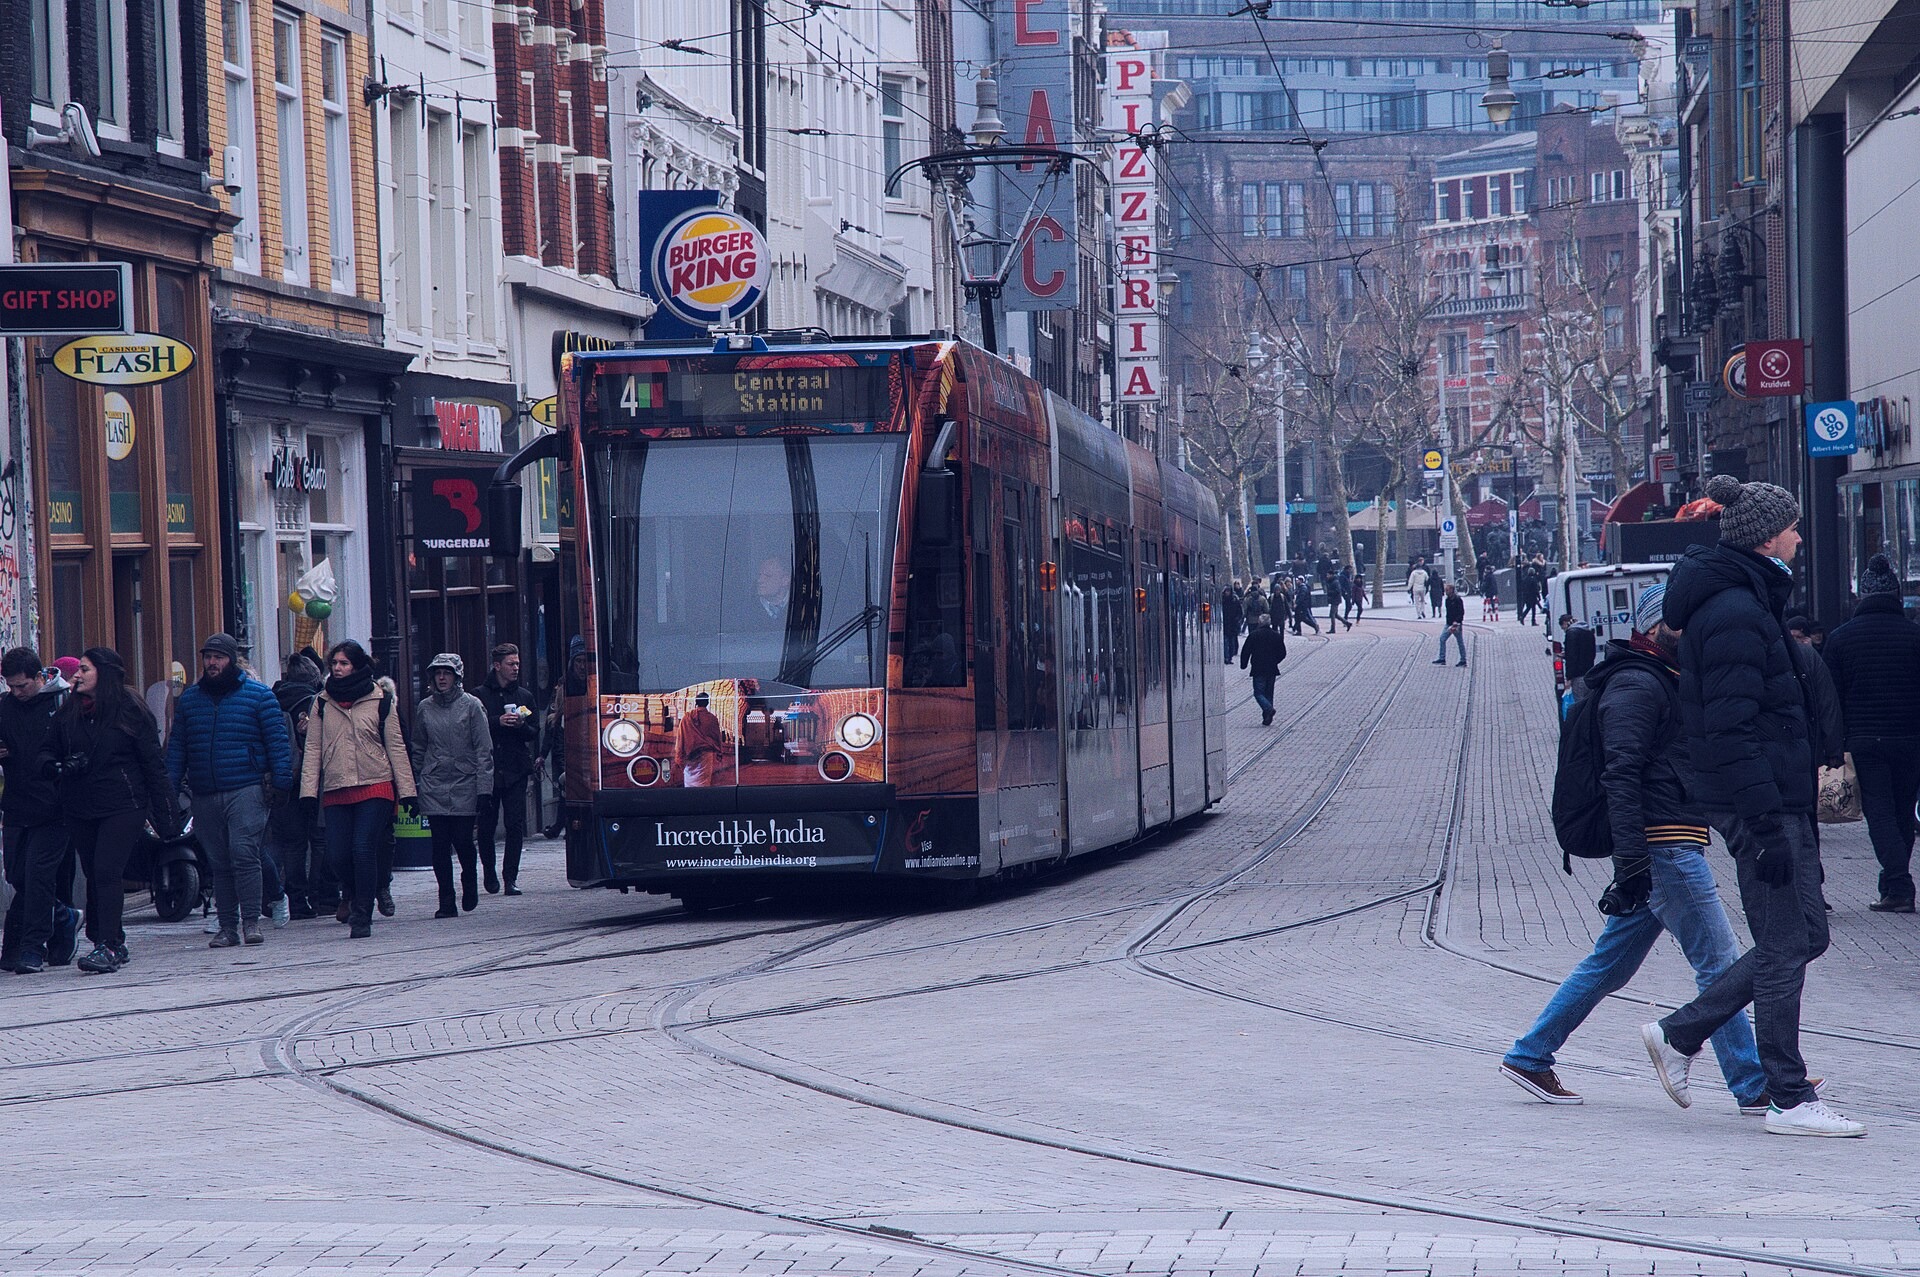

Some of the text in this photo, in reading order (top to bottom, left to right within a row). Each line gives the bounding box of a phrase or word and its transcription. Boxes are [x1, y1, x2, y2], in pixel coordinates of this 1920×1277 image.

[1116, 61, 1155, 396] PIZZERIA
[669, 232, 754, 268] BURGER
[671, 252, 757, 297] KING
[2, 290, 117, 309] GIFT SHOP
[73, 346, 177, 374] FLASH
[734, 370, 830, 392] Centraal
[1760, 380, 1791, 389] Kruidvat
[620, 375, 639, 417] 4
[740, 393, 824, 412] Station
[1820, 413, 1837, 427] to
[1826, 421, 1844, 439] go
[303, 449, 326, 493] Gelato
[606, 702, 640, 714] 2092
[655, 821, 767, 846] Incredible
[921, 840, 932, 853] Visa
[666, 854, 817, 867] www.incredibleindia.org
